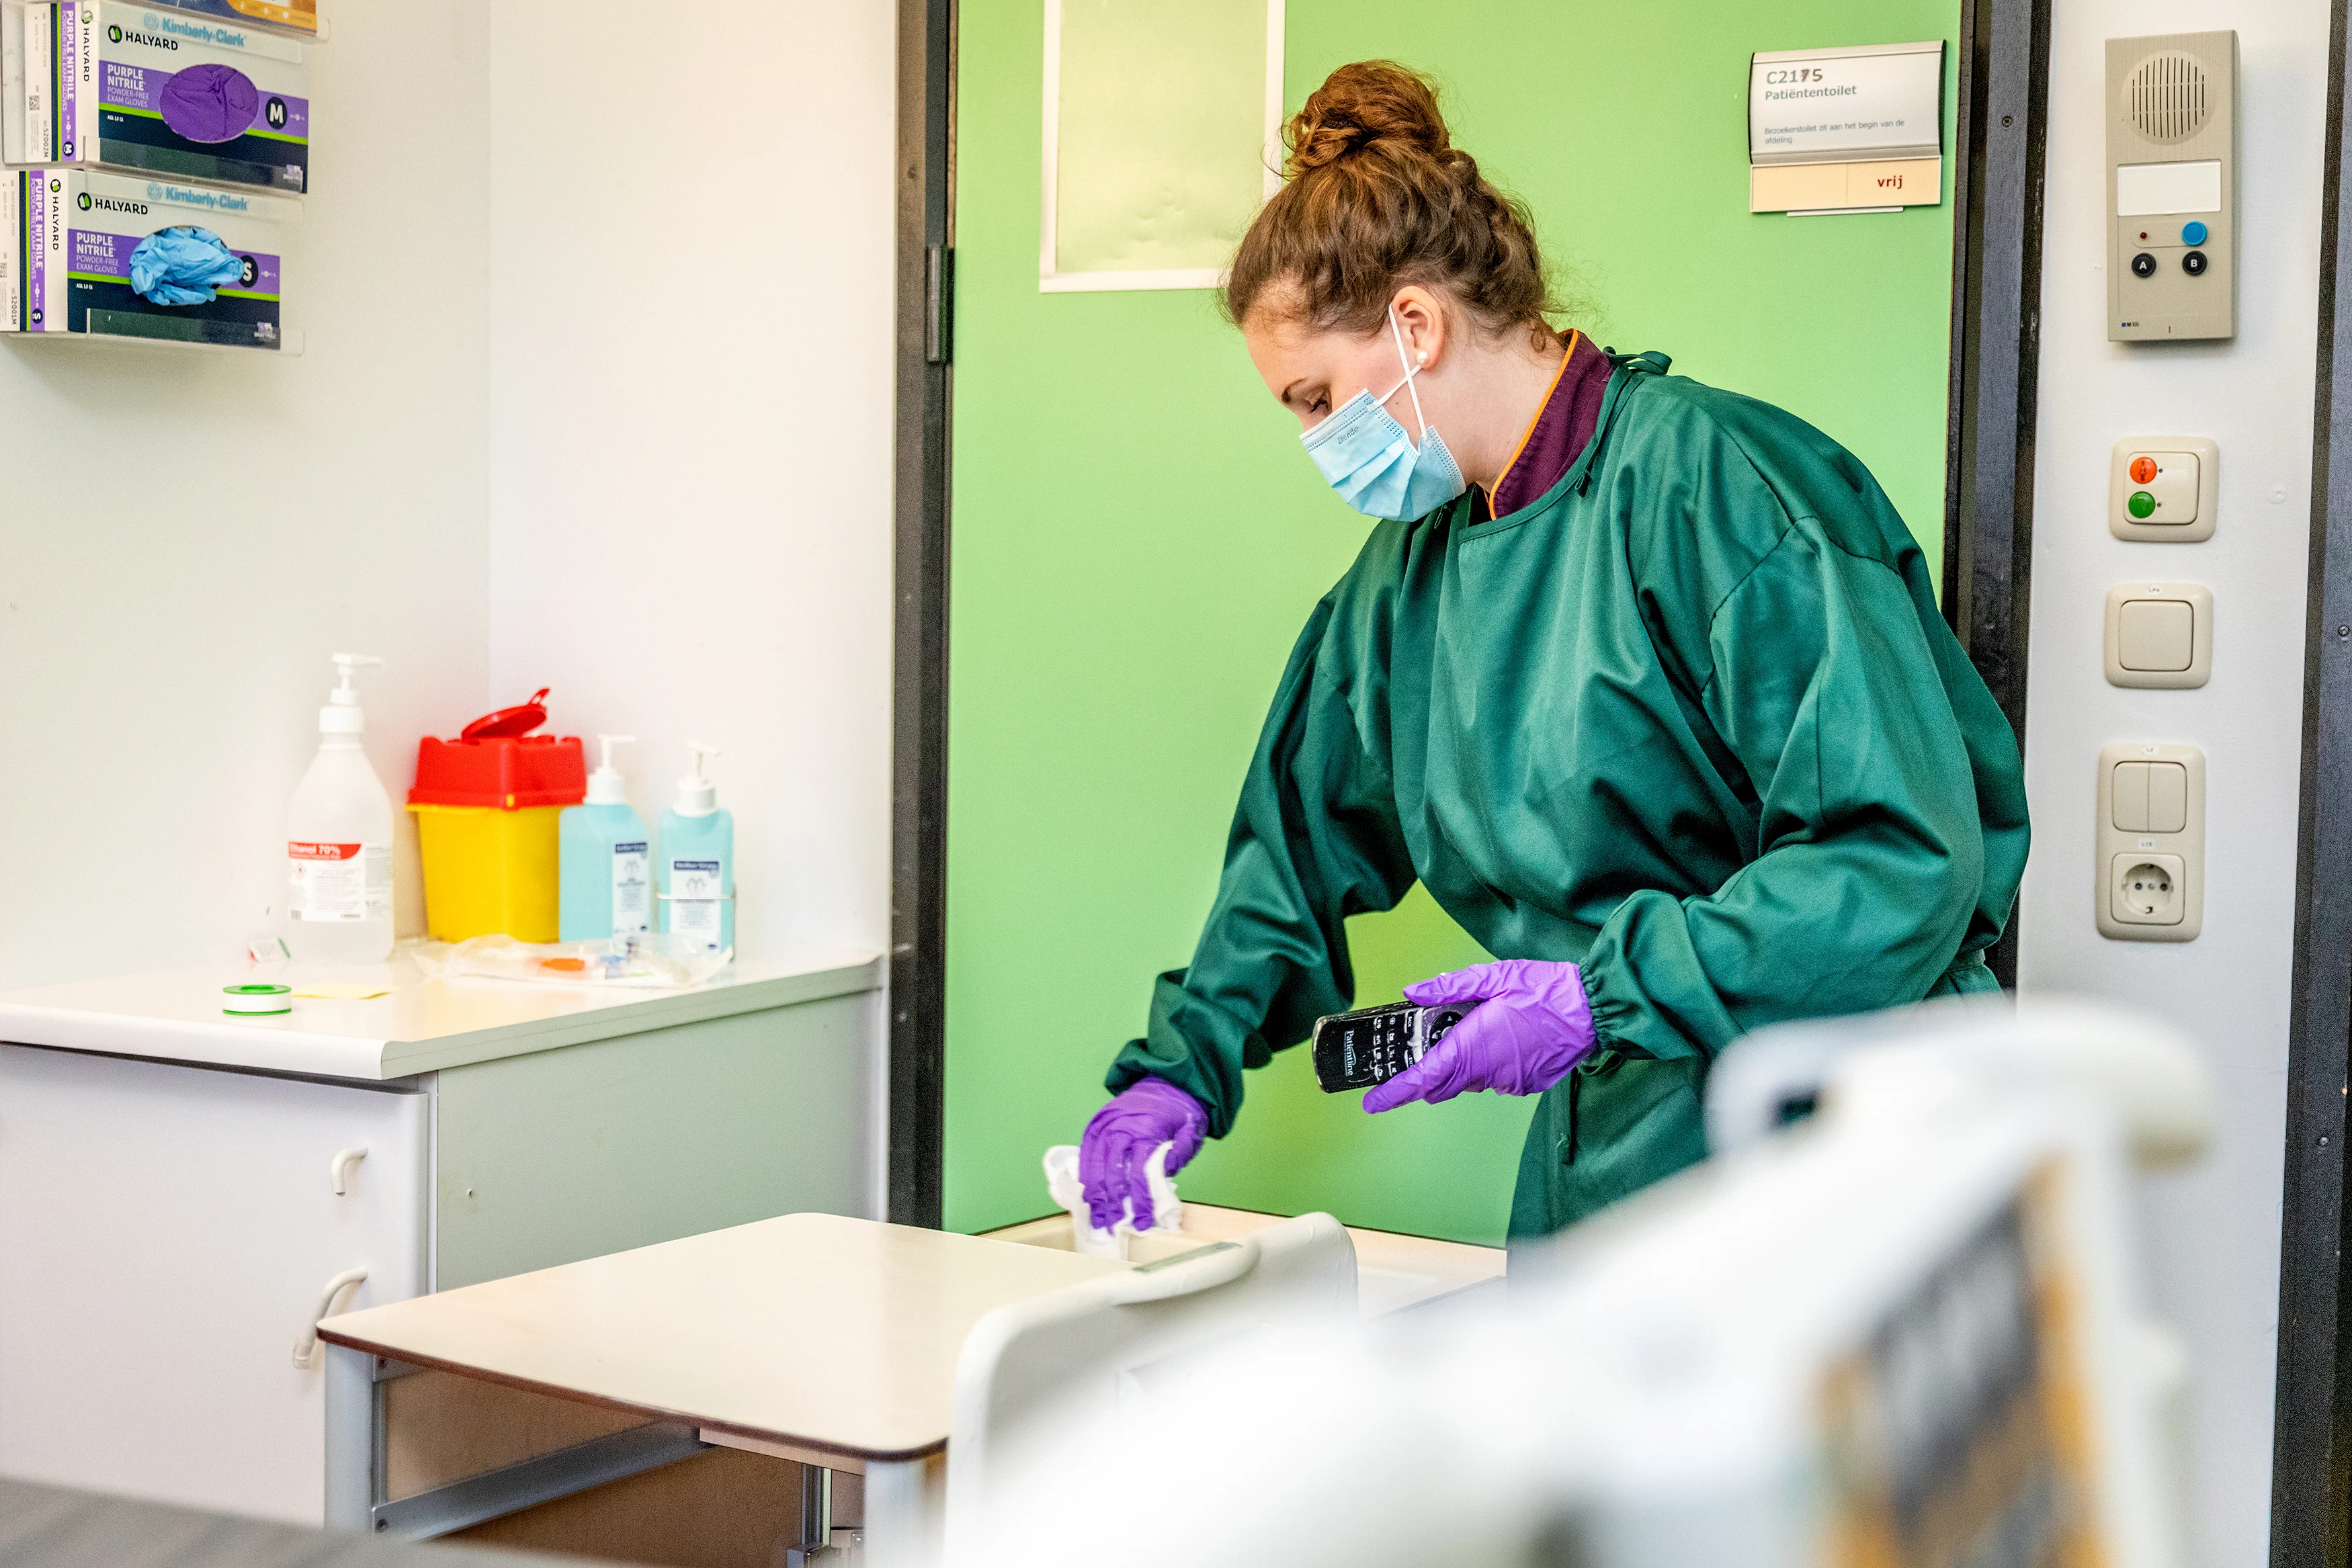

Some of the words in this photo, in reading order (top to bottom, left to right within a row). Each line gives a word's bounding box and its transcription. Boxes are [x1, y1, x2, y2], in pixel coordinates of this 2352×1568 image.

[126, 31, 178, 50] HALYARD
[108, 64, 144, 80] PURPLE
[1766, 69, 1823, 85] C2175
[108, 75, 144, 91] NITRILE
[108, 86, 149, 101] POWDER-FREE
[1765, 85, 1857, 100] Patiëntentoilet
[108, 94, 124, 104] EXAM
[125, 97, 148, 108] GLOVES
[269, 103, 284, 124] M
[1765, 124, 1817, 134] Bezoekerstoilet
[1859, 121, 1879, 130] begin
[1765, 136, 1793, 144] afdeling
[65, 144, 72, 155] M
[1877, 175, 1904, 189] vrij
[95, 198, 148, 215] HALYARD
[77, 232, 113, 247] PURPLE
[77, 244, 114, 257] NITRILE
[76, 255, 119, 267] POWDER-FREE
[76, 262, 93, 271] EXAM
[94, 265, 118, 274] GLOVES
[2139, 261, 2147, 270] A
[2191, 259, 2197, 268] B
[243, 261, 253, 282] S
[1337, 427, 1359, 445] Zhende
[319, 844, 341, 855] 70%
[1347, 1029, 1355, 1076] Patientline
